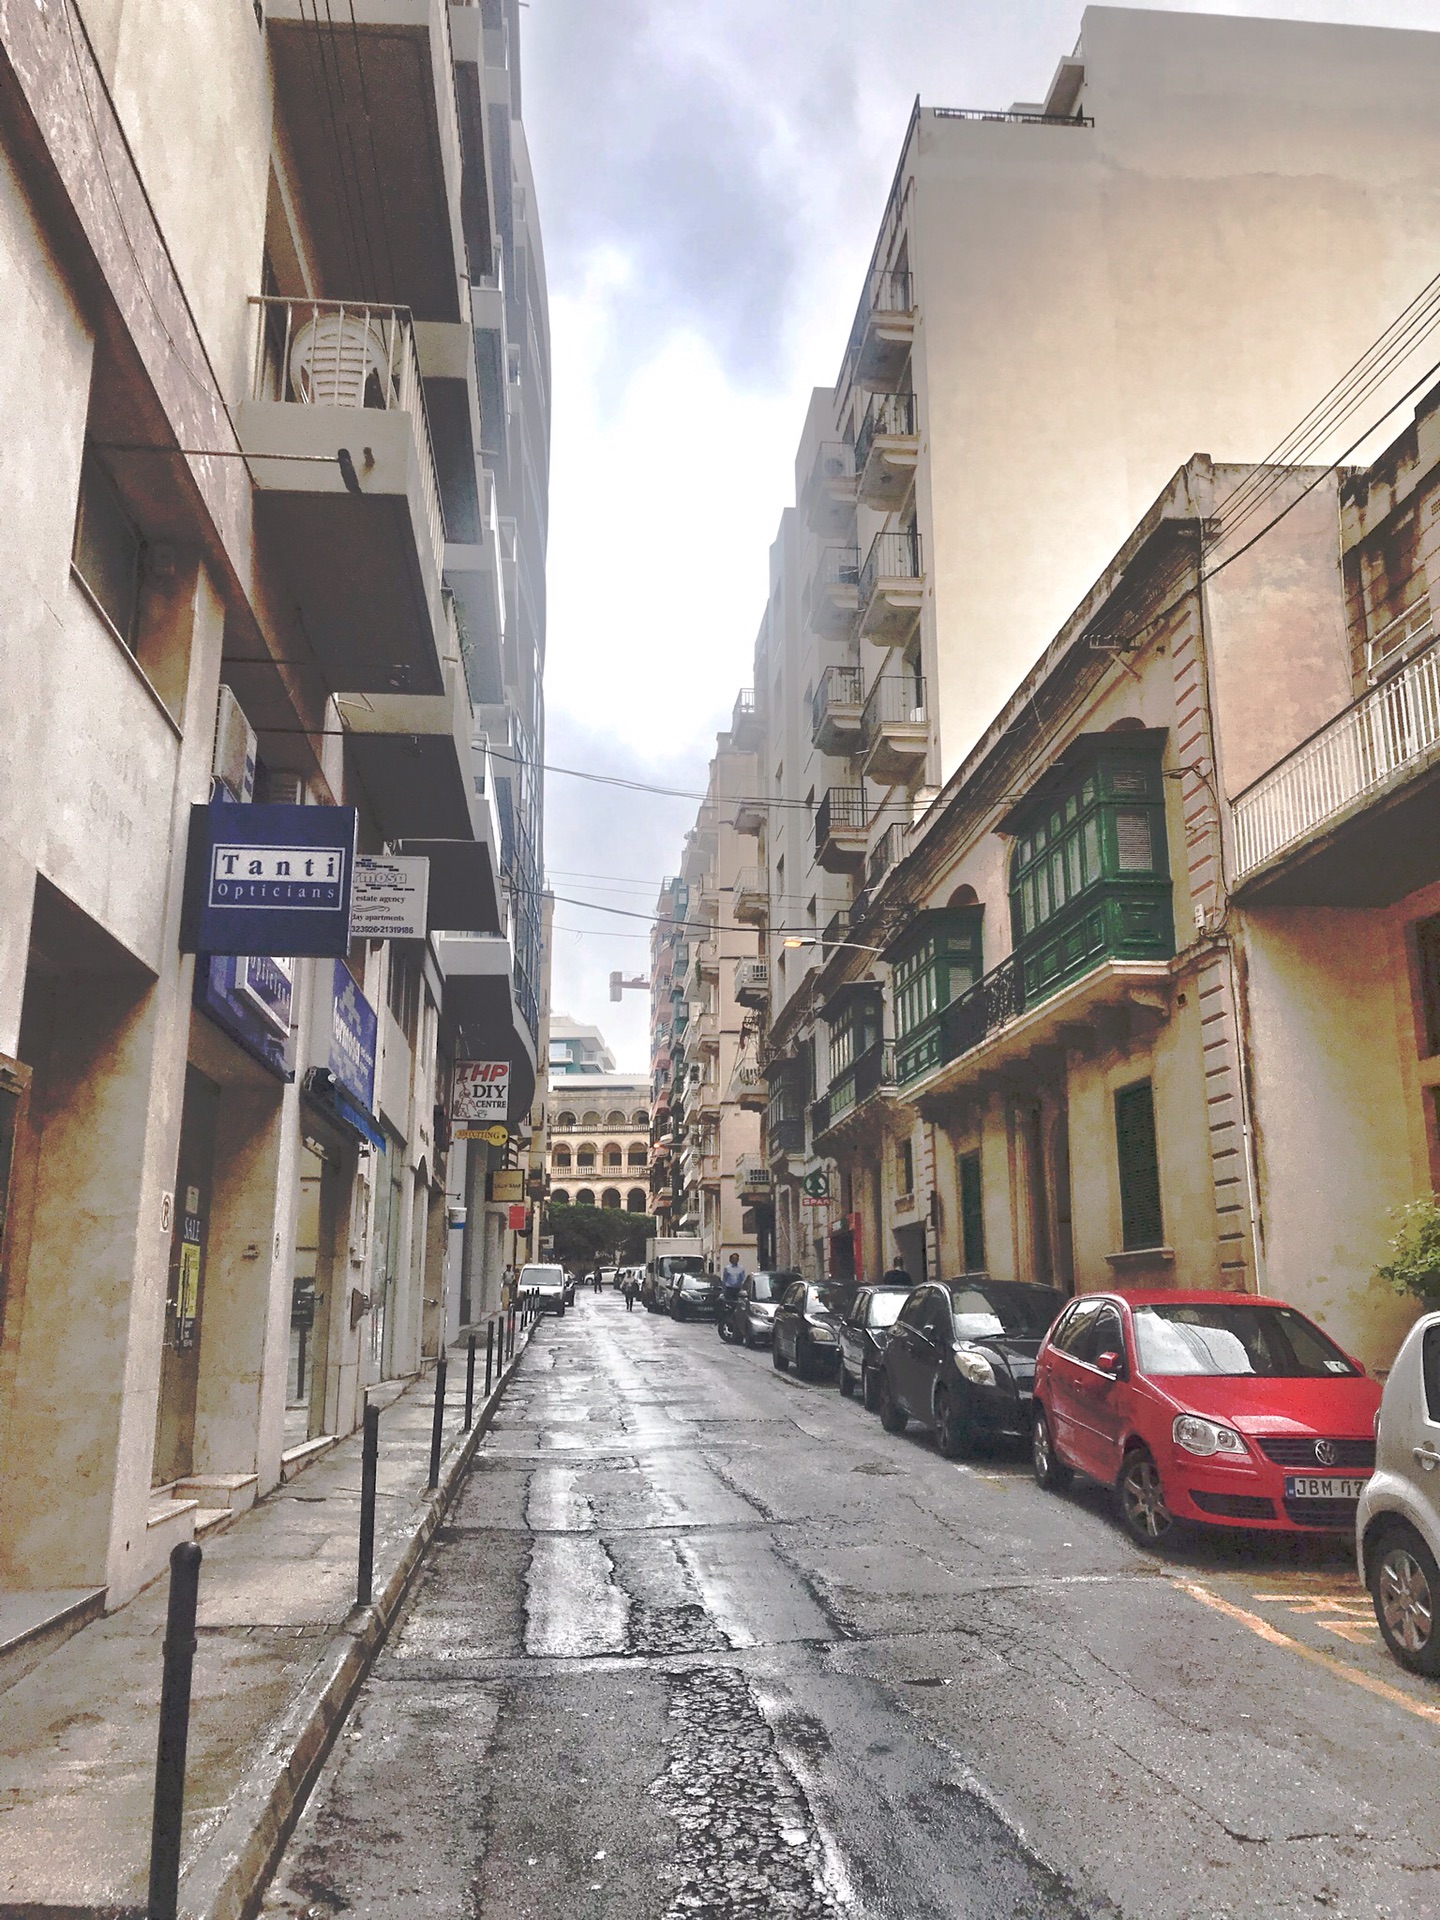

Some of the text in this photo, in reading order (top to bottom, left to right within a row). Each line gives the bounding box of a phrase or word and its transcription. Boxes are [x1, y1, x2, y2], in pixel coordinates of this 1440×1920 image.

[222, 854, 335, 877] Tanti
[354, 872, 407, 884] rmosa
[217, 883, 335, 899] Opticians
[379, 896, 406, 904] agency
[456, 1064, 508, 1082] THP
[472, 1085, 507, 1098] DIY
[184, 1217, 201, 1242] SALE
[1296, 1480, 1333, 1496] JBM
